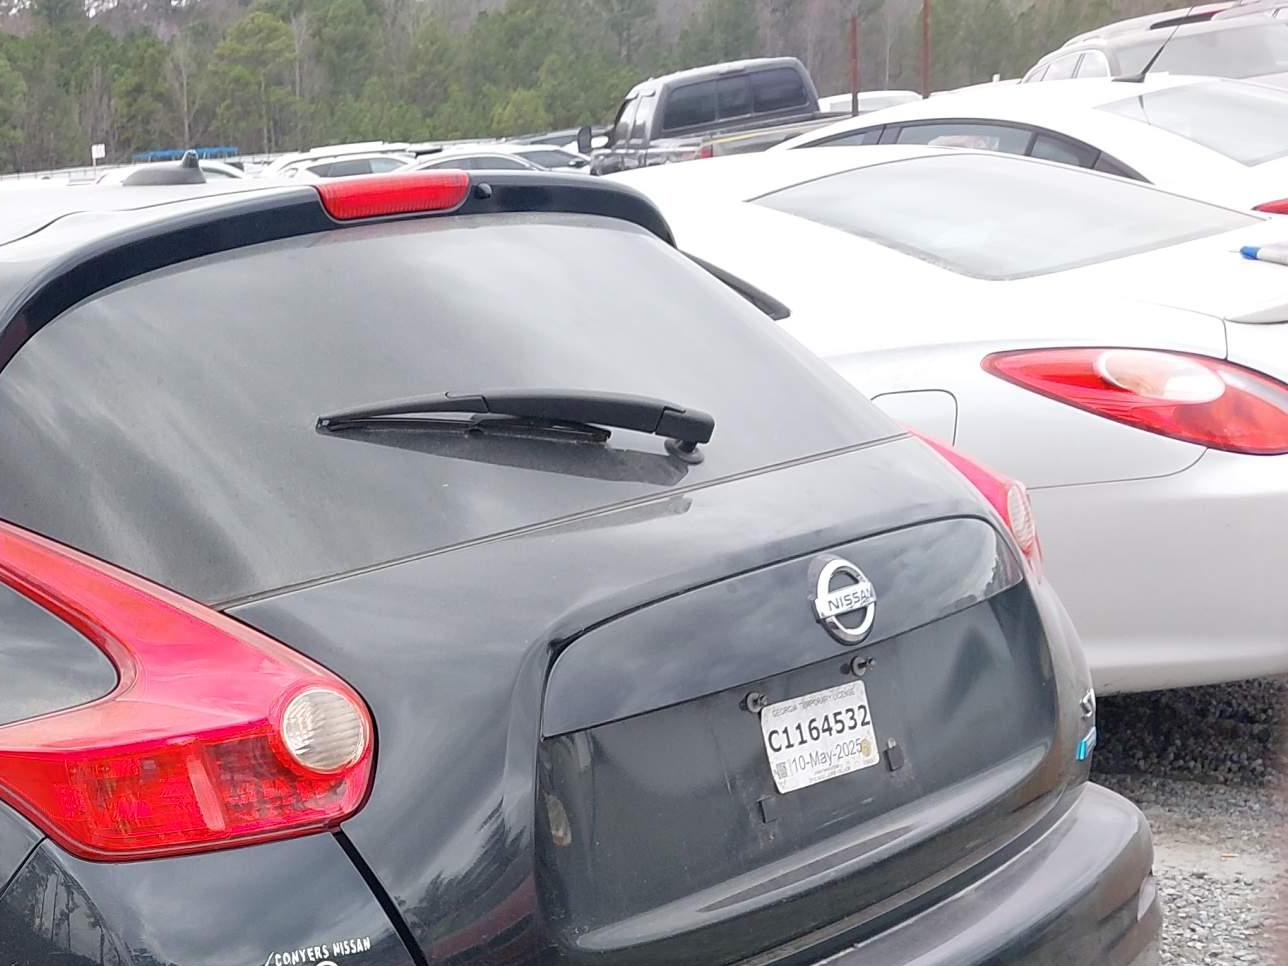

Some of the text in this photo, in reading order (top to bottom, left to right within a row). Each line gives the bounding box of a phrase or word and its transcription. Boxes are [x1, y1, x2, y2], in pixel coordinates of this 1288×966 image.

[767, 704, 871, 753] C1164532
[791, 738, 863, 773] 10-May-2025
[332, 937, 371, 957] NISSAN
